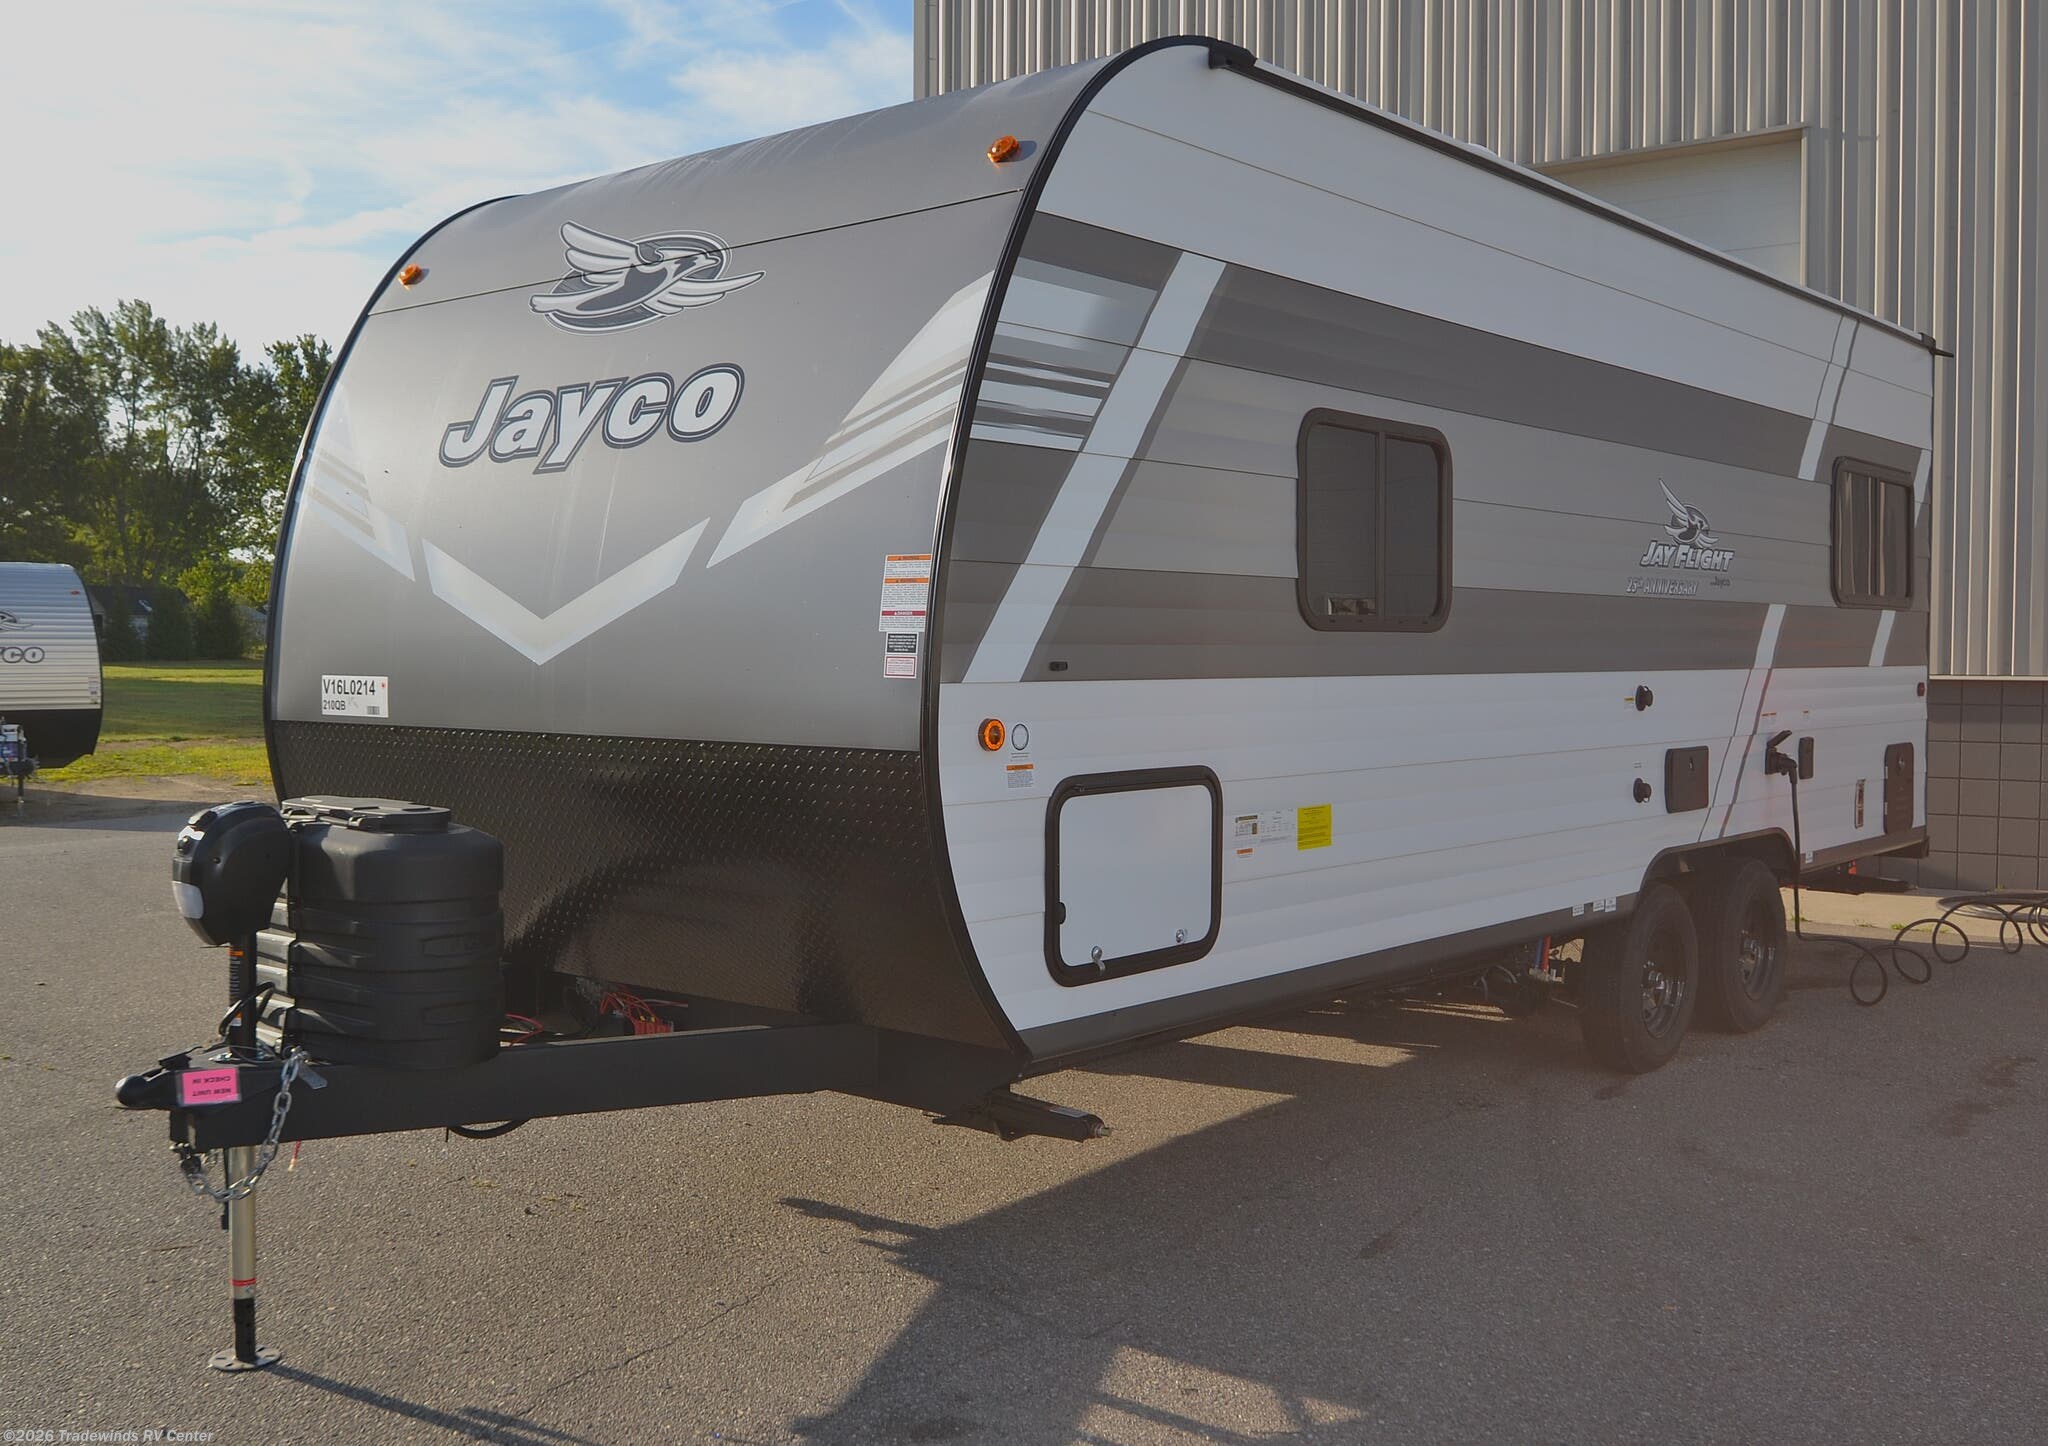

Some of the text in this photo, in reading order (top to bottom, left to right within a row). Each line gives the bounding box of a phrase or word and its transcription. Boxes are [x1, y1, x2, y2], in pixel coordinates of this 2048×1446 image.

[439, 363, 745, 475] Jayco
[1640, 540, 1735, 572] JAY FLIGHT
[322, 679, 376, 695] V16L0214
